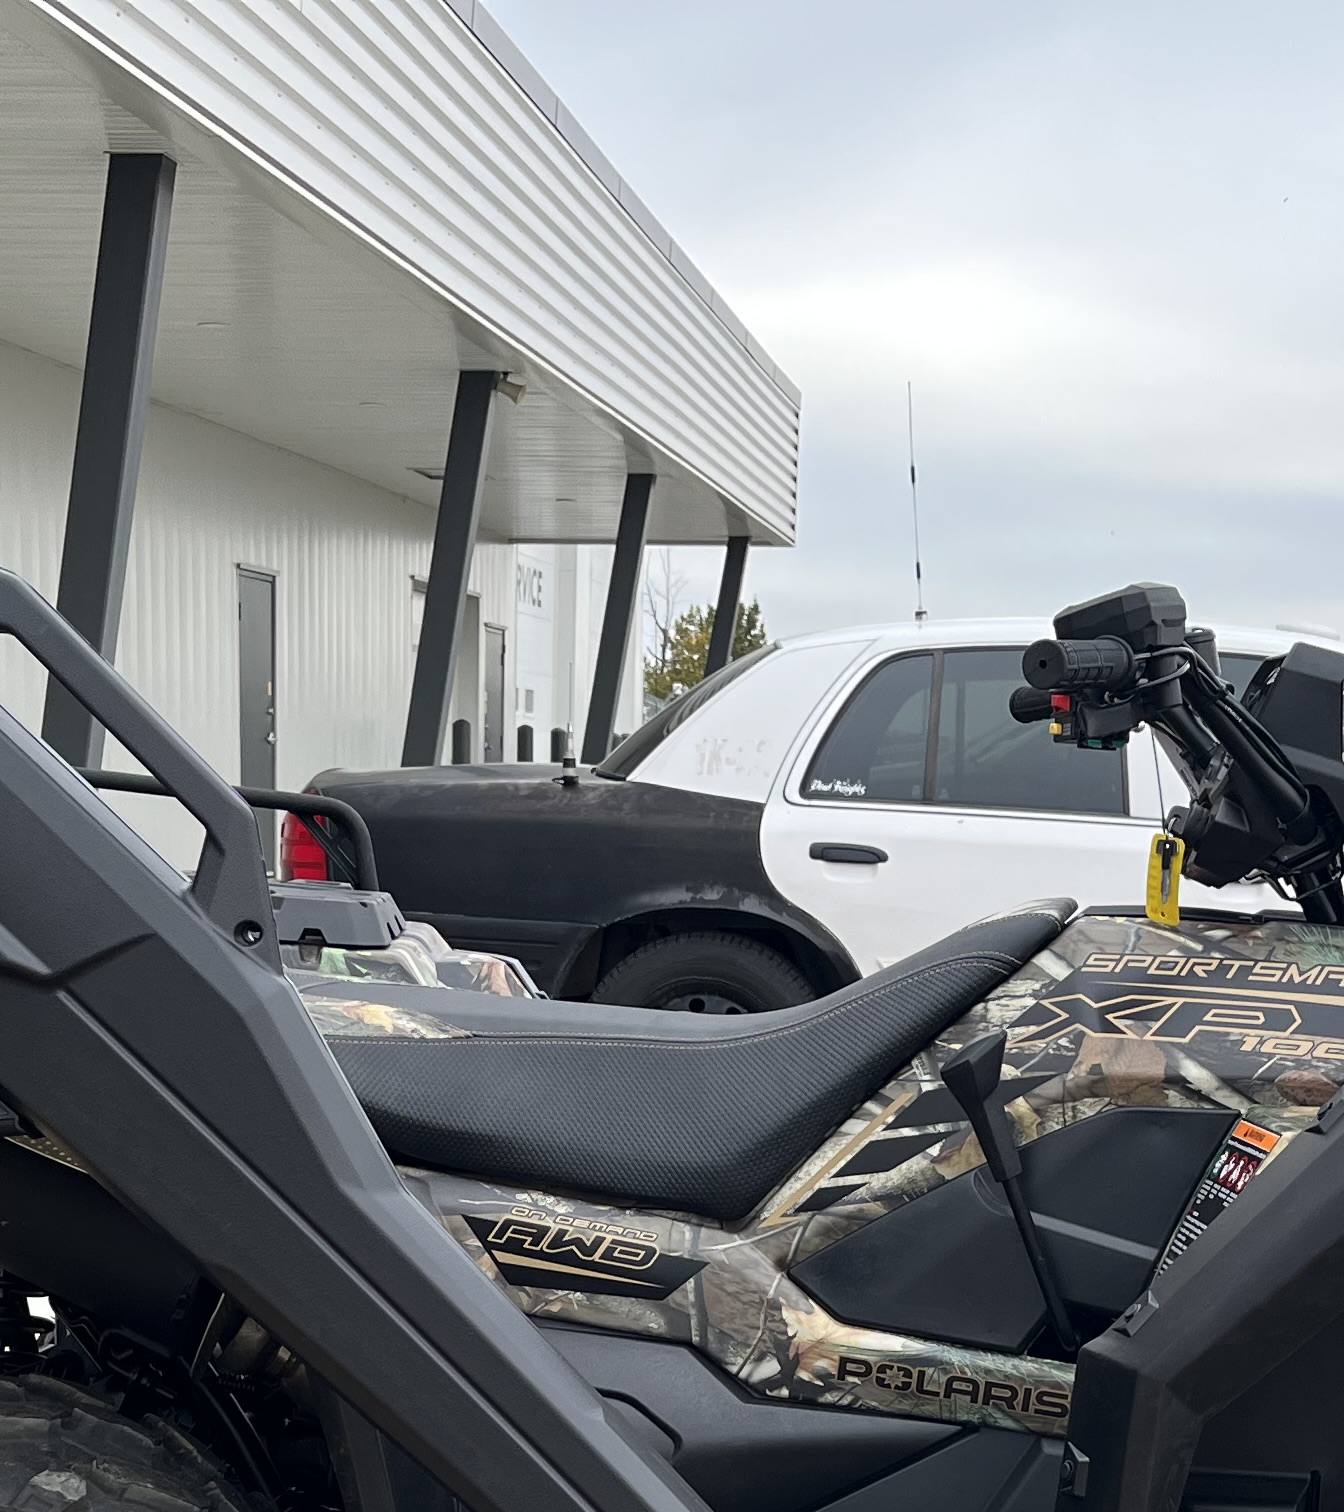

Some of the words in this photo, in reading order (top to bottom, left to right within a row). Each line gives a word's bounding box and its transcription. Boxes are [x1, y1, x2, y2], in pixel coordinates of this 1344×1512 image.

[1004, 993, 1302, 1045] XP
[487, 1216, 660, 1270] AWD
[511, 1207, 546, 1219] ON
[555, 1216, 658, 1241] DEMAND
[836, 1356, 1071, 1419] POLARIS
